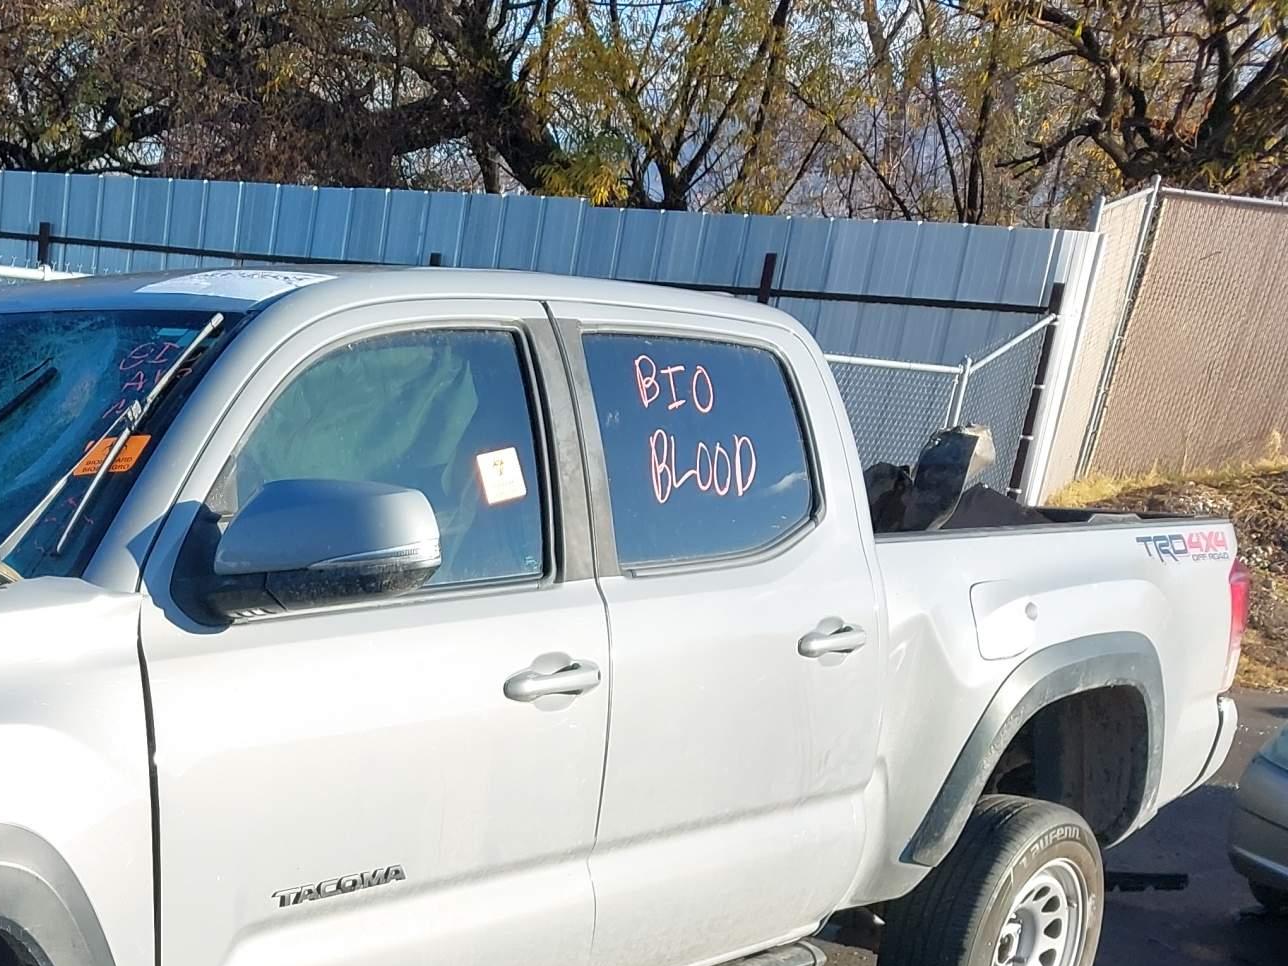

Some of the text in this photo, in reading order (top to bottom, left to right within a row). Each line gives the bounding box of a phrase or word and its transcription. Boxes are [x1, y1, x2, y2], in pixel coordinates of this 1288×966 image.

[633, 354, 715, 414] BIO
[648, 428, 757, 504] BLOOD
[1135, 533, 1189, 562] TRD
[1191, 551, 1230, 561] OFF ROAD
[271, 863, 407, 908] TACOMA
